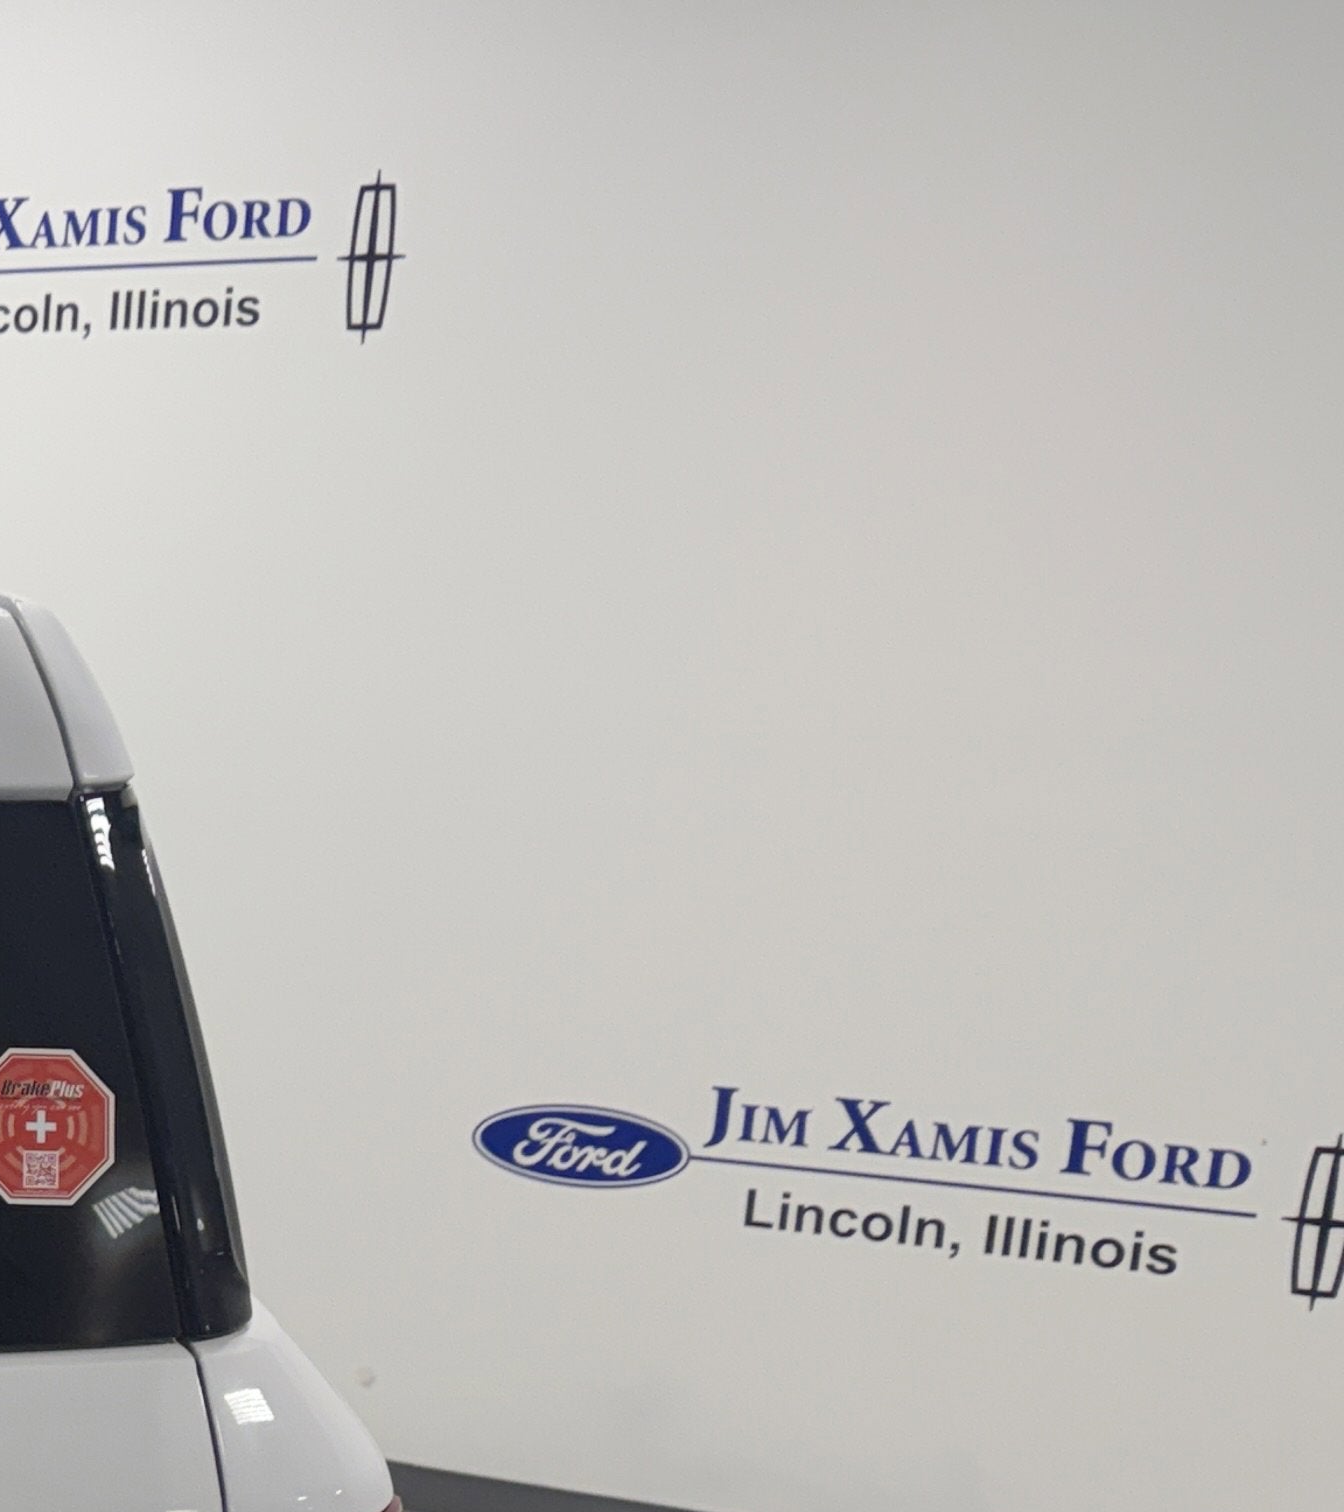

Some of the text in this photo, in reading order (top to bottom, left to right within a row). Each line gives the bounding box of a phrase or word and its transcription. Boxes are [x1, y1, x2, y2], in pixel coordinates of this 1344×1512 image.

[163, 187, 312, 242] FORD
[109, 287, 260, 329] Illinois
[512, 1117, 645, 1178] Ford
[703, 1086, 1252, 1191] JIM XAMIS FORD
[743, 1188, 1178, 1275] Lincoln, Illinois
